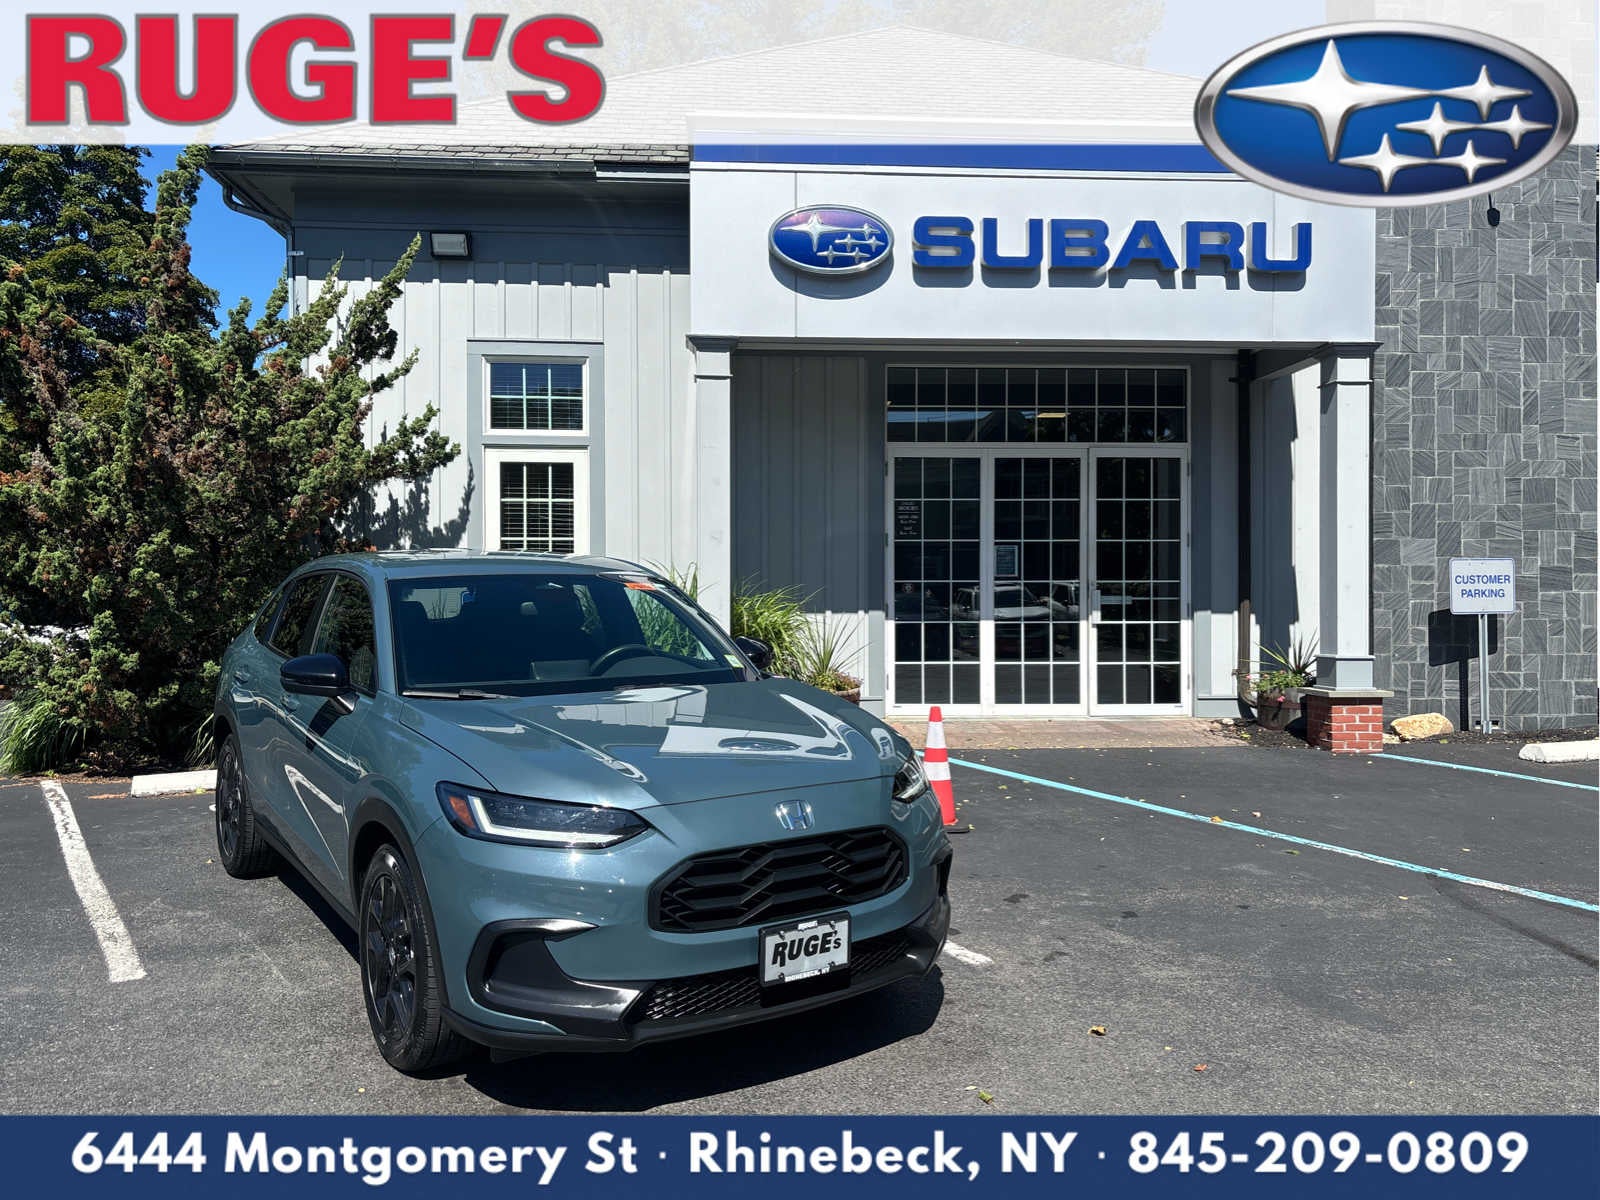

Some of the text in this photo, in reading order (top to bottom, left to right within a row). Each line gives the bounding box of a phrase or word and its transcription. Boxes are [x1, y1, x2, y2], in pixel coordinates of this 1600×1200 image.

[912, 216, 1312, 272] SUBARU
[1454, 574, 1511, 585] CUSTOMER
[1461, 588, 1505, 598] PARKING
